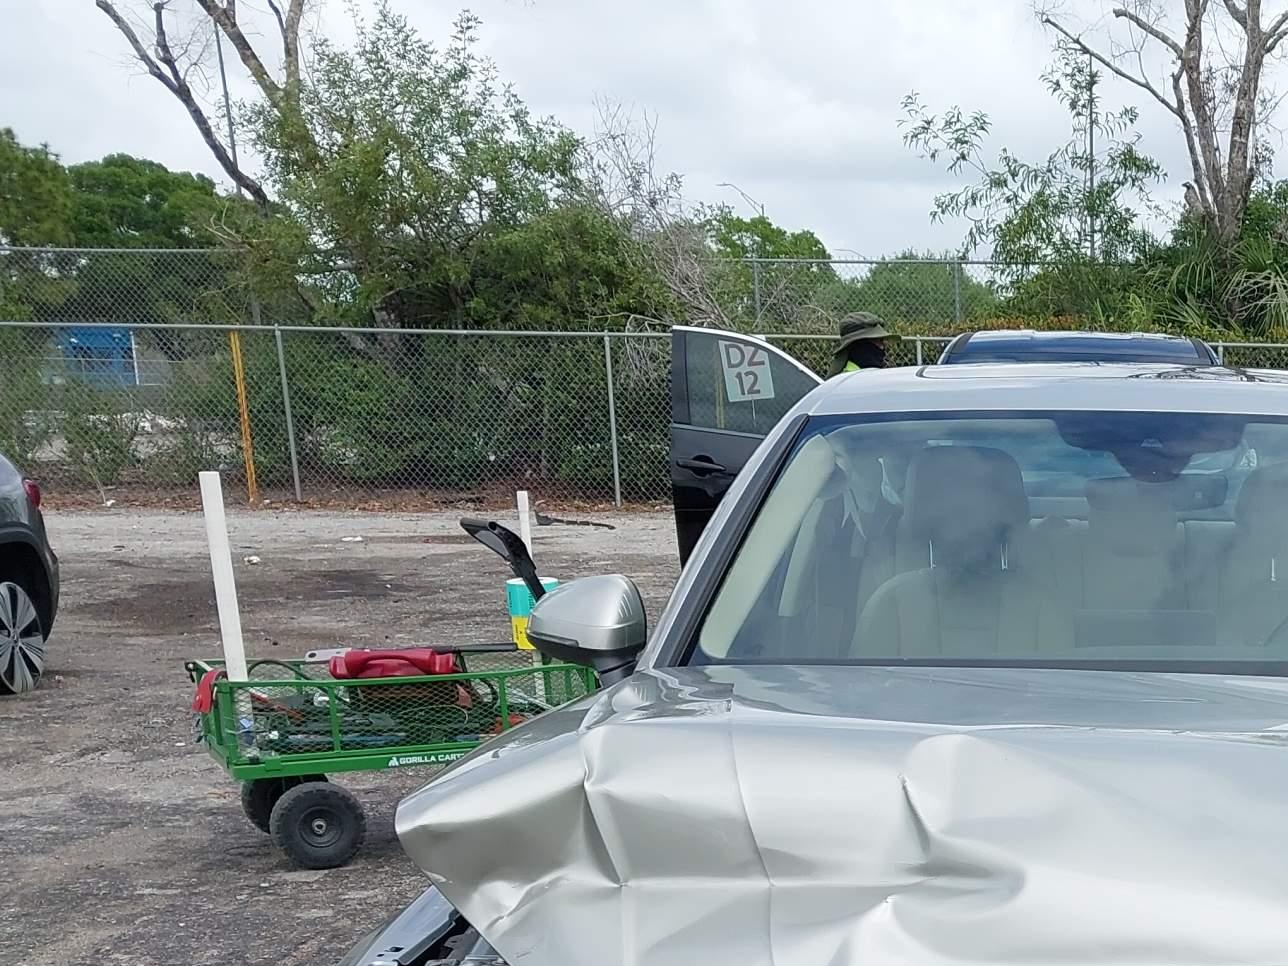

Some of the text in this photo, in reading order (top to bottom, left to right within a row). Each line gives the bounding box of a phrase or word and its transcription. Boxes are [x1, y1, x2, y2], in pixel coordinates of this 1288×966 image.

[735, 370, 760, 396] 12
[400, 753, 464, 765] GORILLA CART
